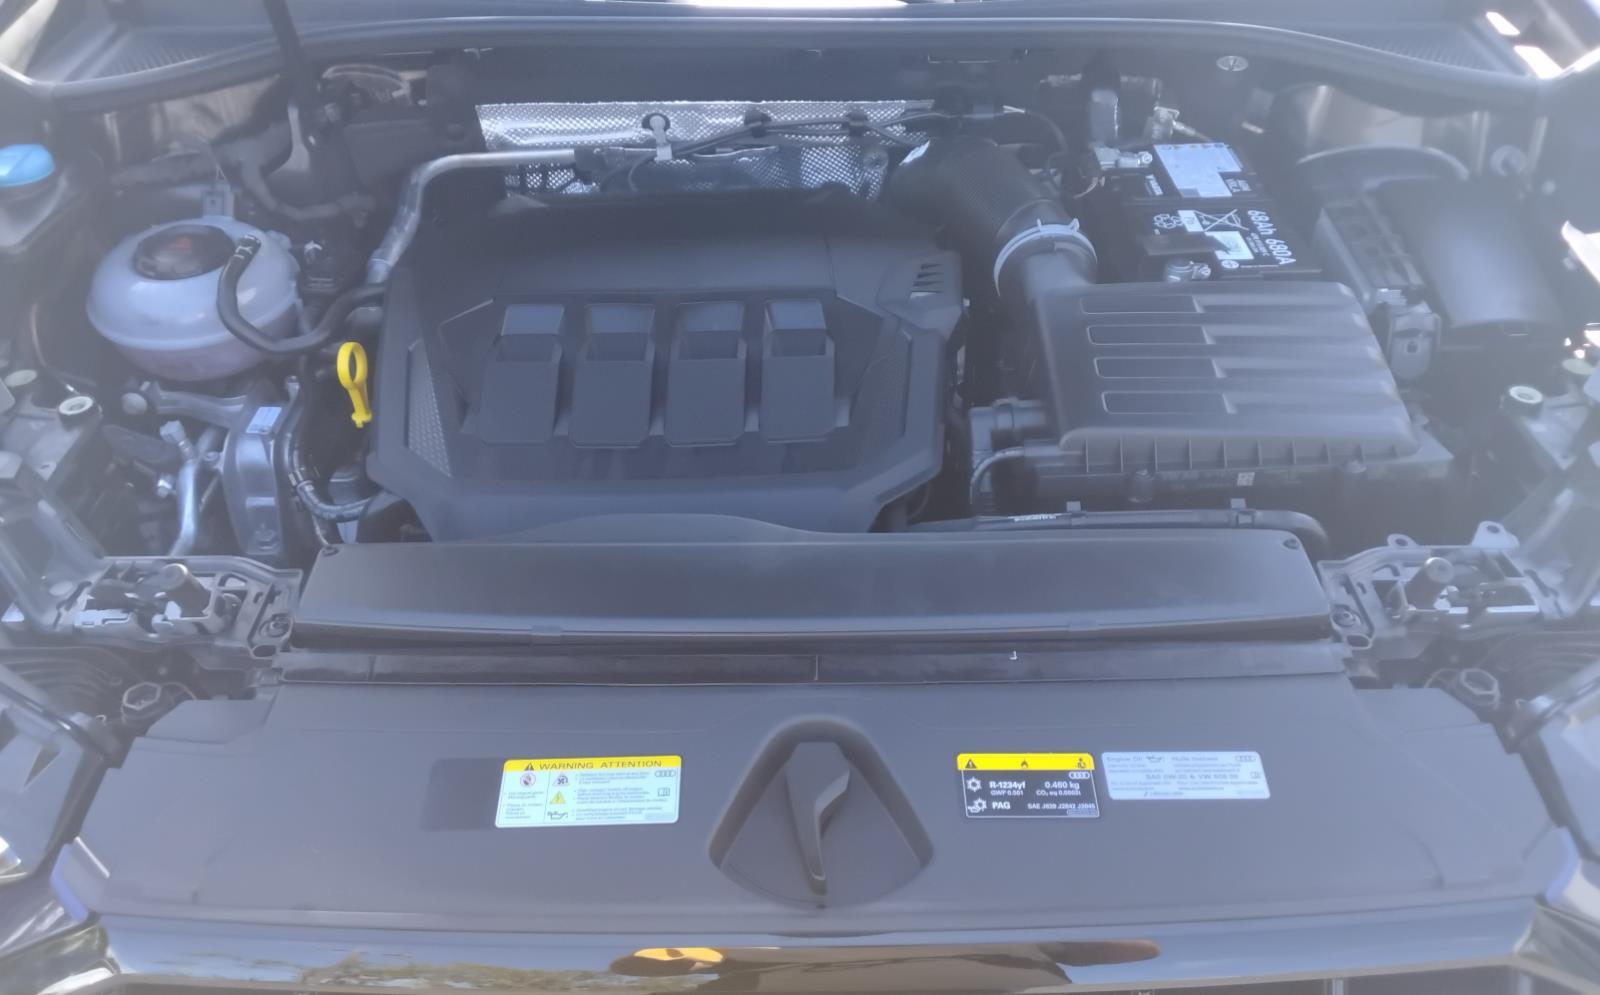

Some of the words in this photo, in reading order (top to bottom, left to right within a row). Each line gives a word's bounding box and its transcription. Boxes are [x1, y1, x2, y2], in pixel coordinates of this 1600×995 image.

[1247, 209, 1277, 236] 68Ah
[1265, 238, 1297, 266] 680A
[539, 762, 594, 770] WARNING
[600, 760, 662, 769] ATTENTION
[989, 781, 1026, 791] R-1234yf
[1069, 780, 1080, 791] kg
[992, 801, 1011, 810] PAG
